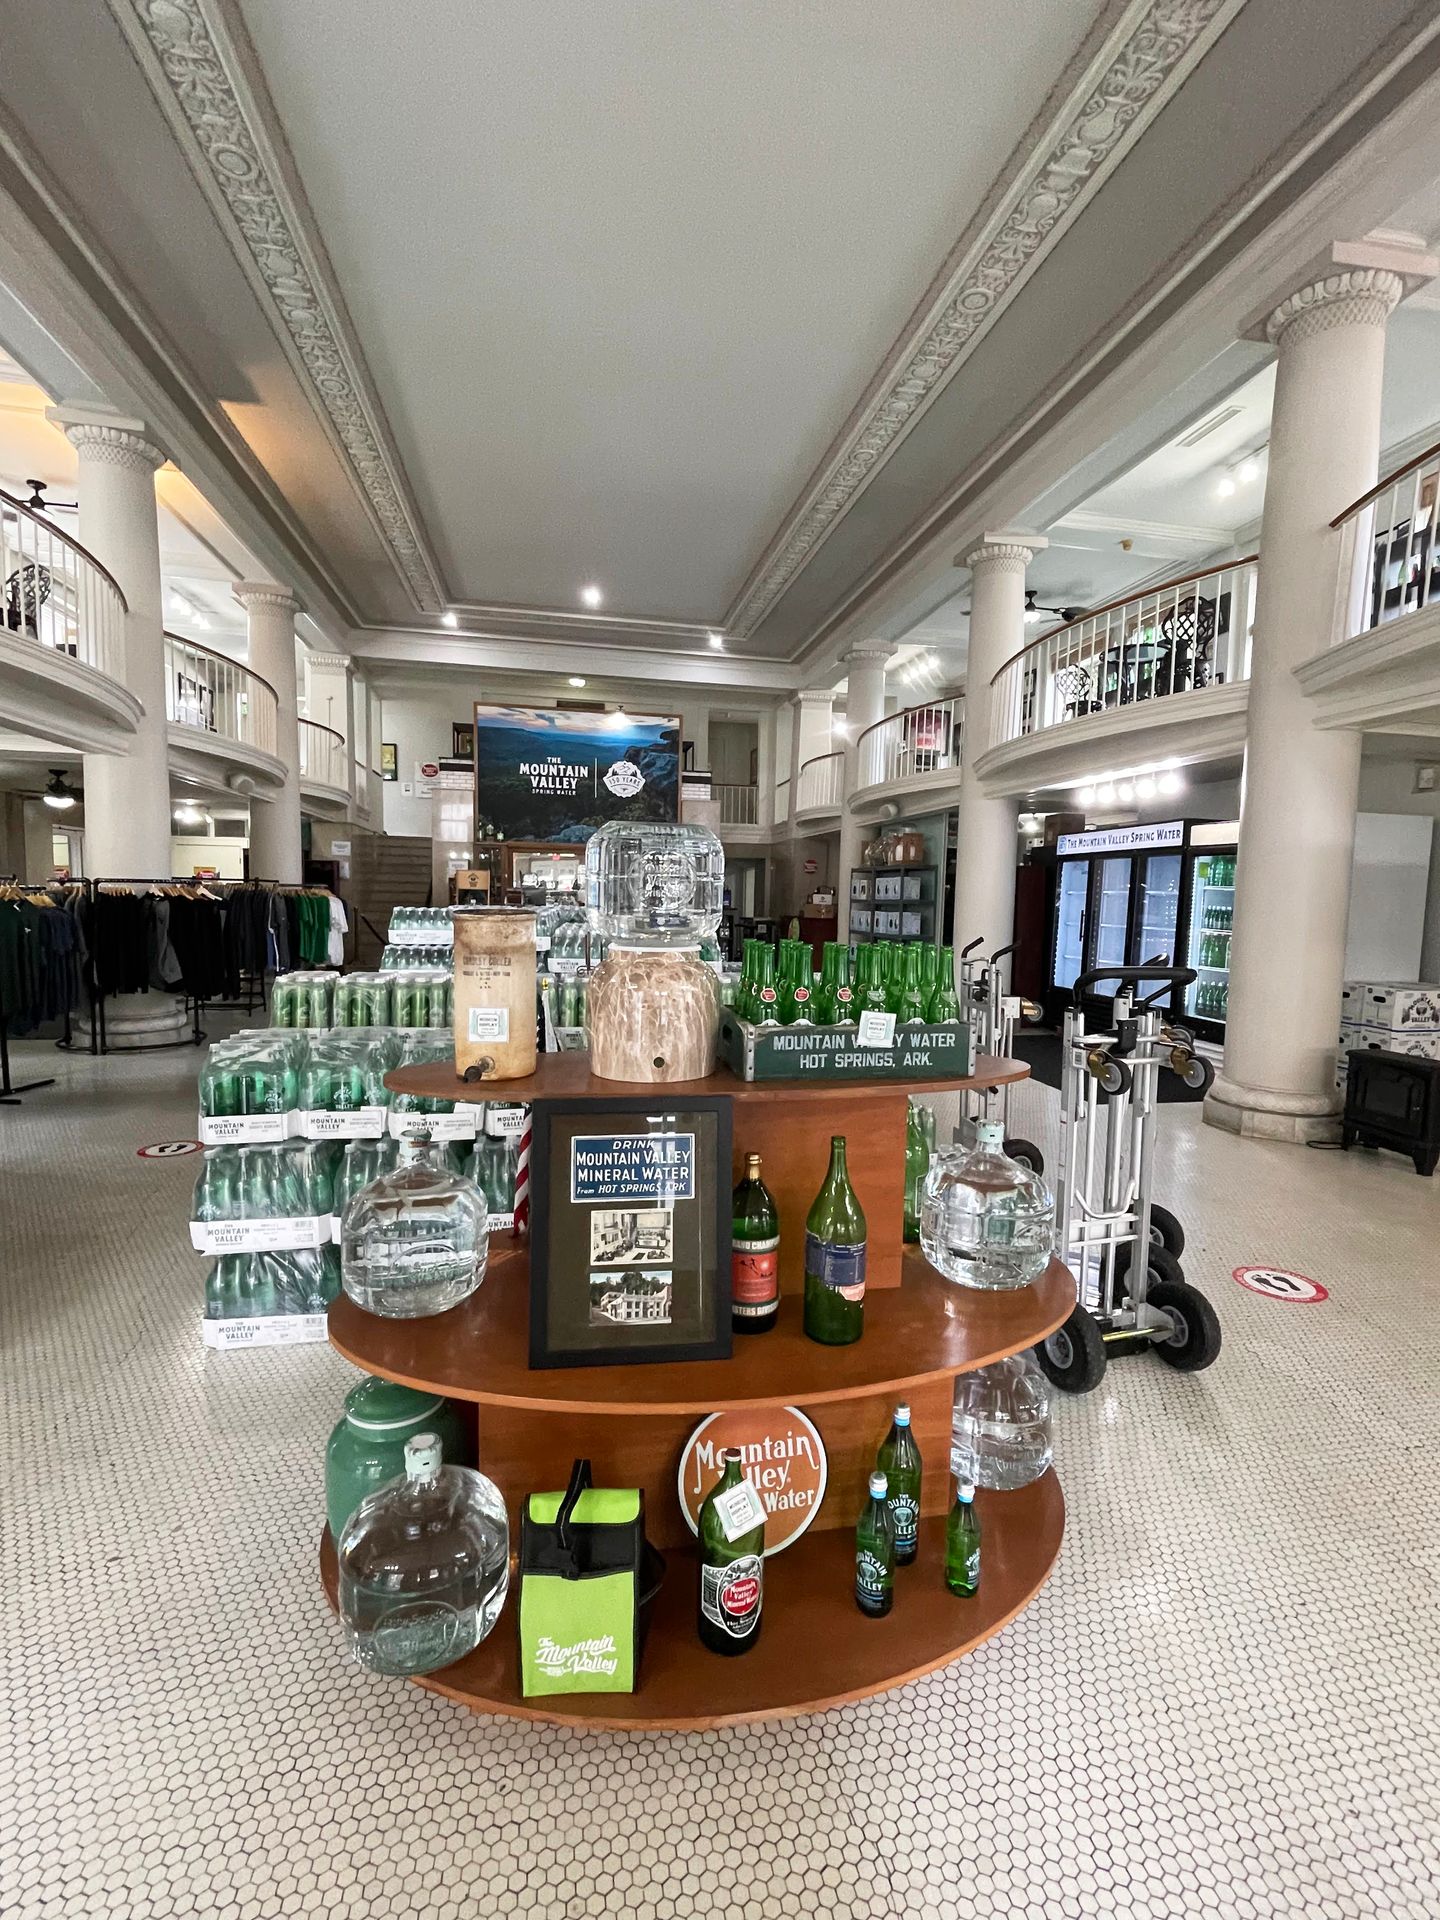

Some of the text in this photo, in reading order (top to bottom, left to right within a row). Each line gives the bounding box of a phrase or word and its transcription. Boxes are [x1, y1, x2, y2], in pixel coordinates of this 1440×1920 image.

[519, 763, 589, 778] MOUNTAIN
[530, 776, 578, 789] VALLEY
[622, 776, 641, 787] YEARS
[1078, 837, 1107, 848] MOUNTAIN
[1108, 833, 1130, 845] VALLEY
[1130, 832, 1155, 843] SPRING
[1156, 829, 1181, 840] WATER
[773, 1034, 846, 1050] MOUNTAIN
[909, 1033, 956, 1048] WATER
[800, 1051, 933, 1069] HOT SPRINGS, ARK.
[208, 1122, 245, 1130] MOUNTAIN
[310, 1117, 346, 1125] MOUNTAIN
[612, 1140, 655, 1150] DRINK
[576, 1150, 691, 1166] MOUNTAIN VALLEY
[578, 1166, 689, 1183] MINERAL WATER
[598, 1184, 618, 1194] HOT
[620, 1182, 661, 1193] SPRINGS
[207, 1227, 250, 1236] MOUNTAIN
[215, 1235, 243, 1243] VALLEY
[218, 1325, 261, 1334] MOUNTAIN
[226, 1332, 254, 1340] VALLEY
[763, 1488, 815, 1513] Water
[534, 1634, 617, 1665] Mountain
[566, 1651, 618, 1676] Valley
